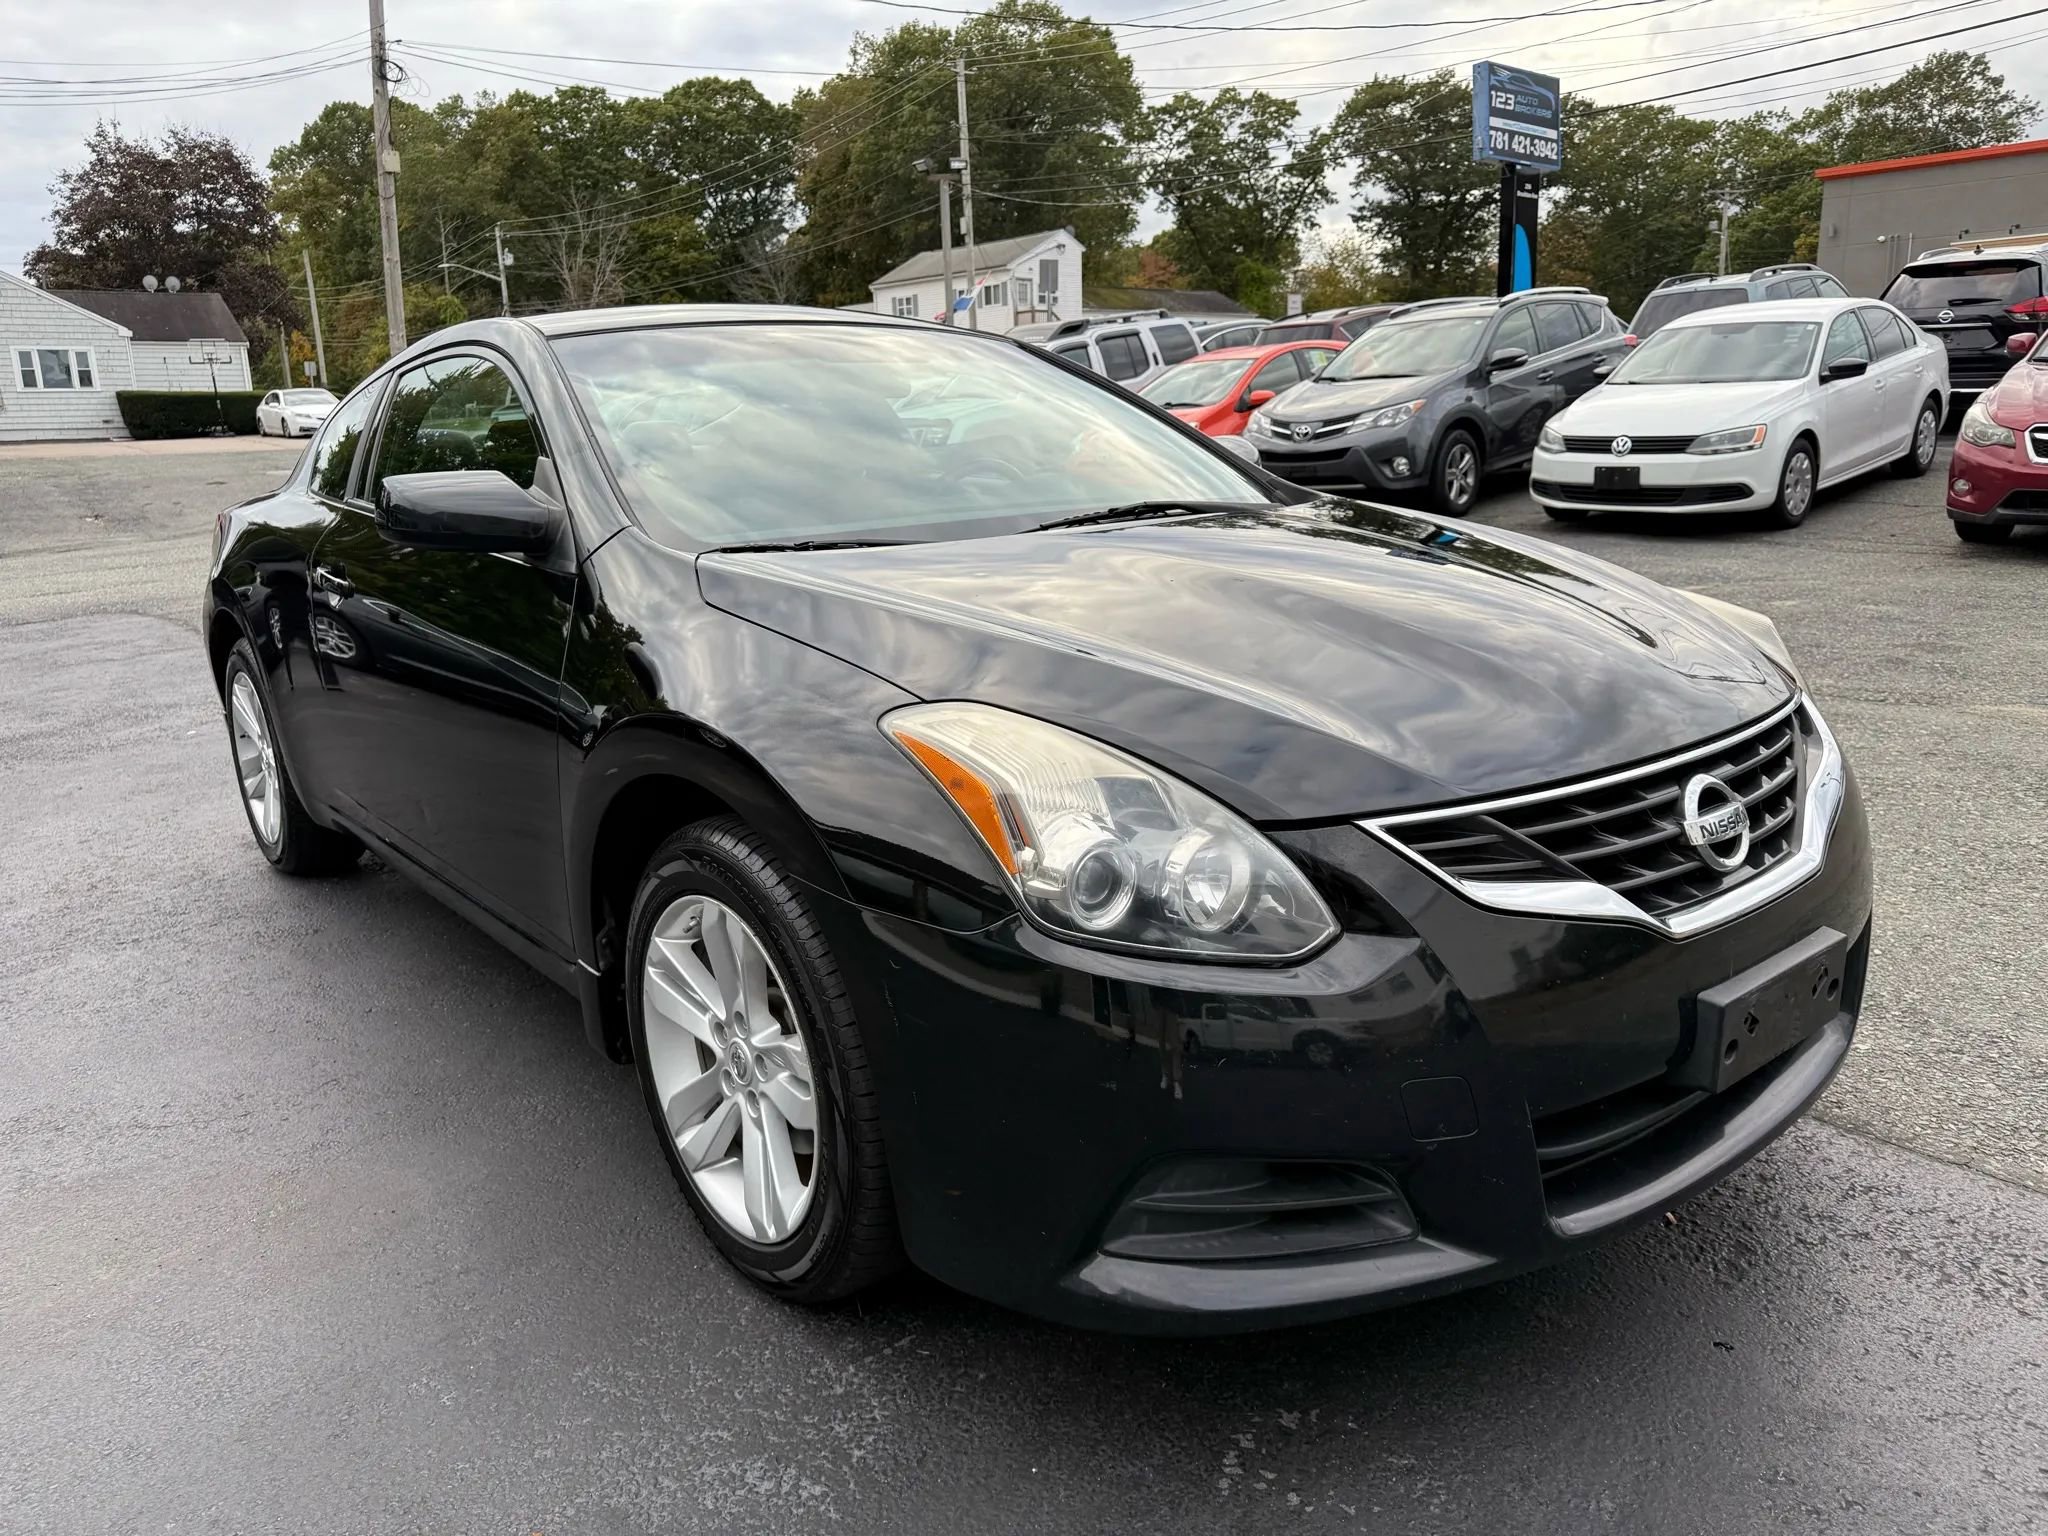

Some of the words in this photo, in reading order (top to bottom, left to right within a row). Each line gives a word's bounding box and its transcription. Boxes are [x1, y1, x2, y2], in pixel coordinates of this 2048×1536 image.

[1491, 91, 1515, 111] 123
[1516, 95, 1539, 106] AUTO
[1490, 131, 1509, 149] 781
[1512, 135, 1558, 159] 421-3942
